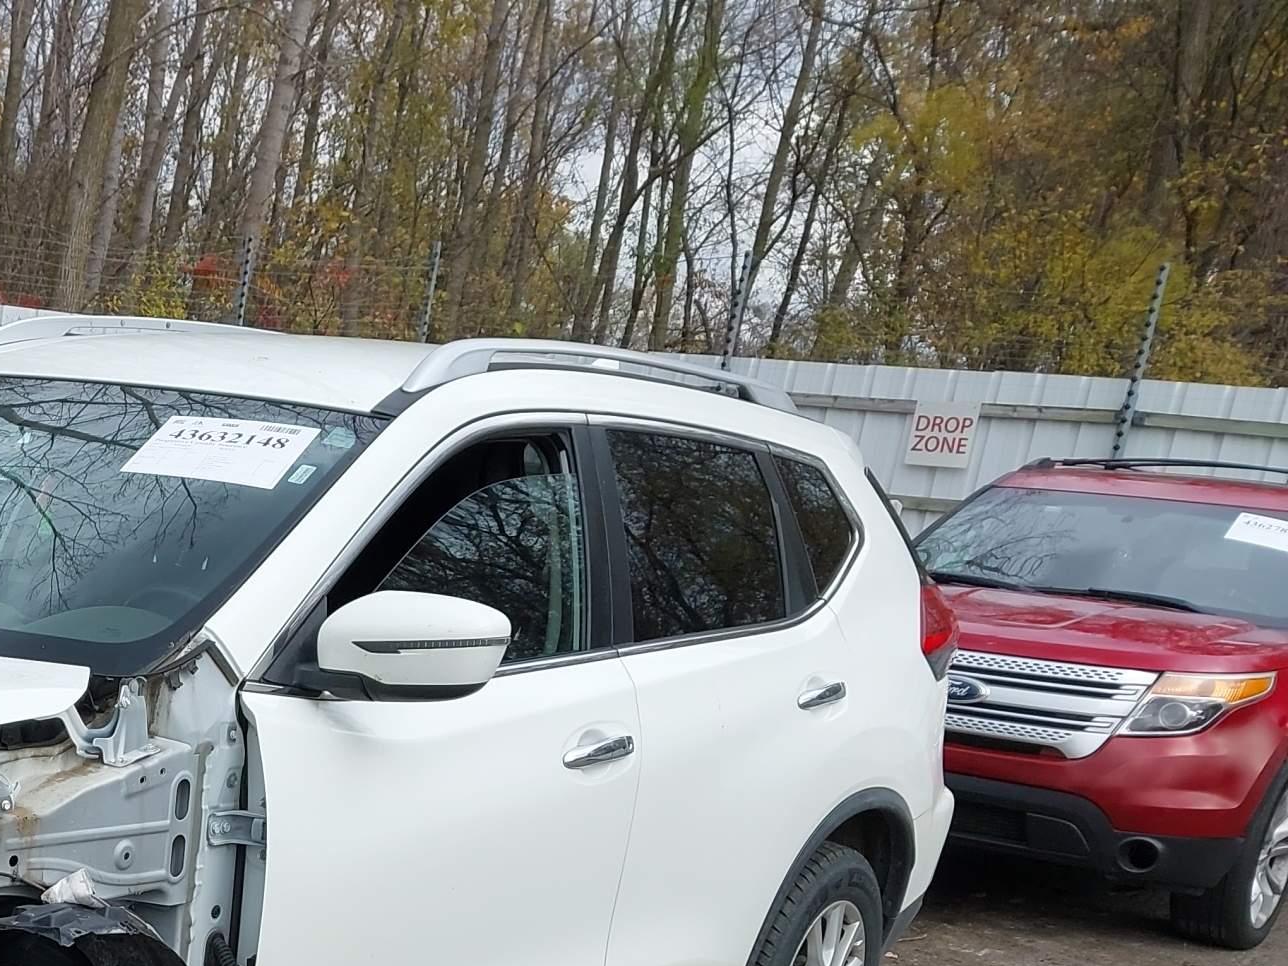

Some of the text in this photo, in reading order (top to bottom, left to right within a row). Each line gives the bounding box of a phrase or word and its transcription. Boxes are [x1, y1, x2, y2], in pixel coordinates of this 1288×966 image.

[915, 415, 974, 434] DROP
[169, 428, 290, 449] 43632148
[910, 434, 969, 454] ZONE
